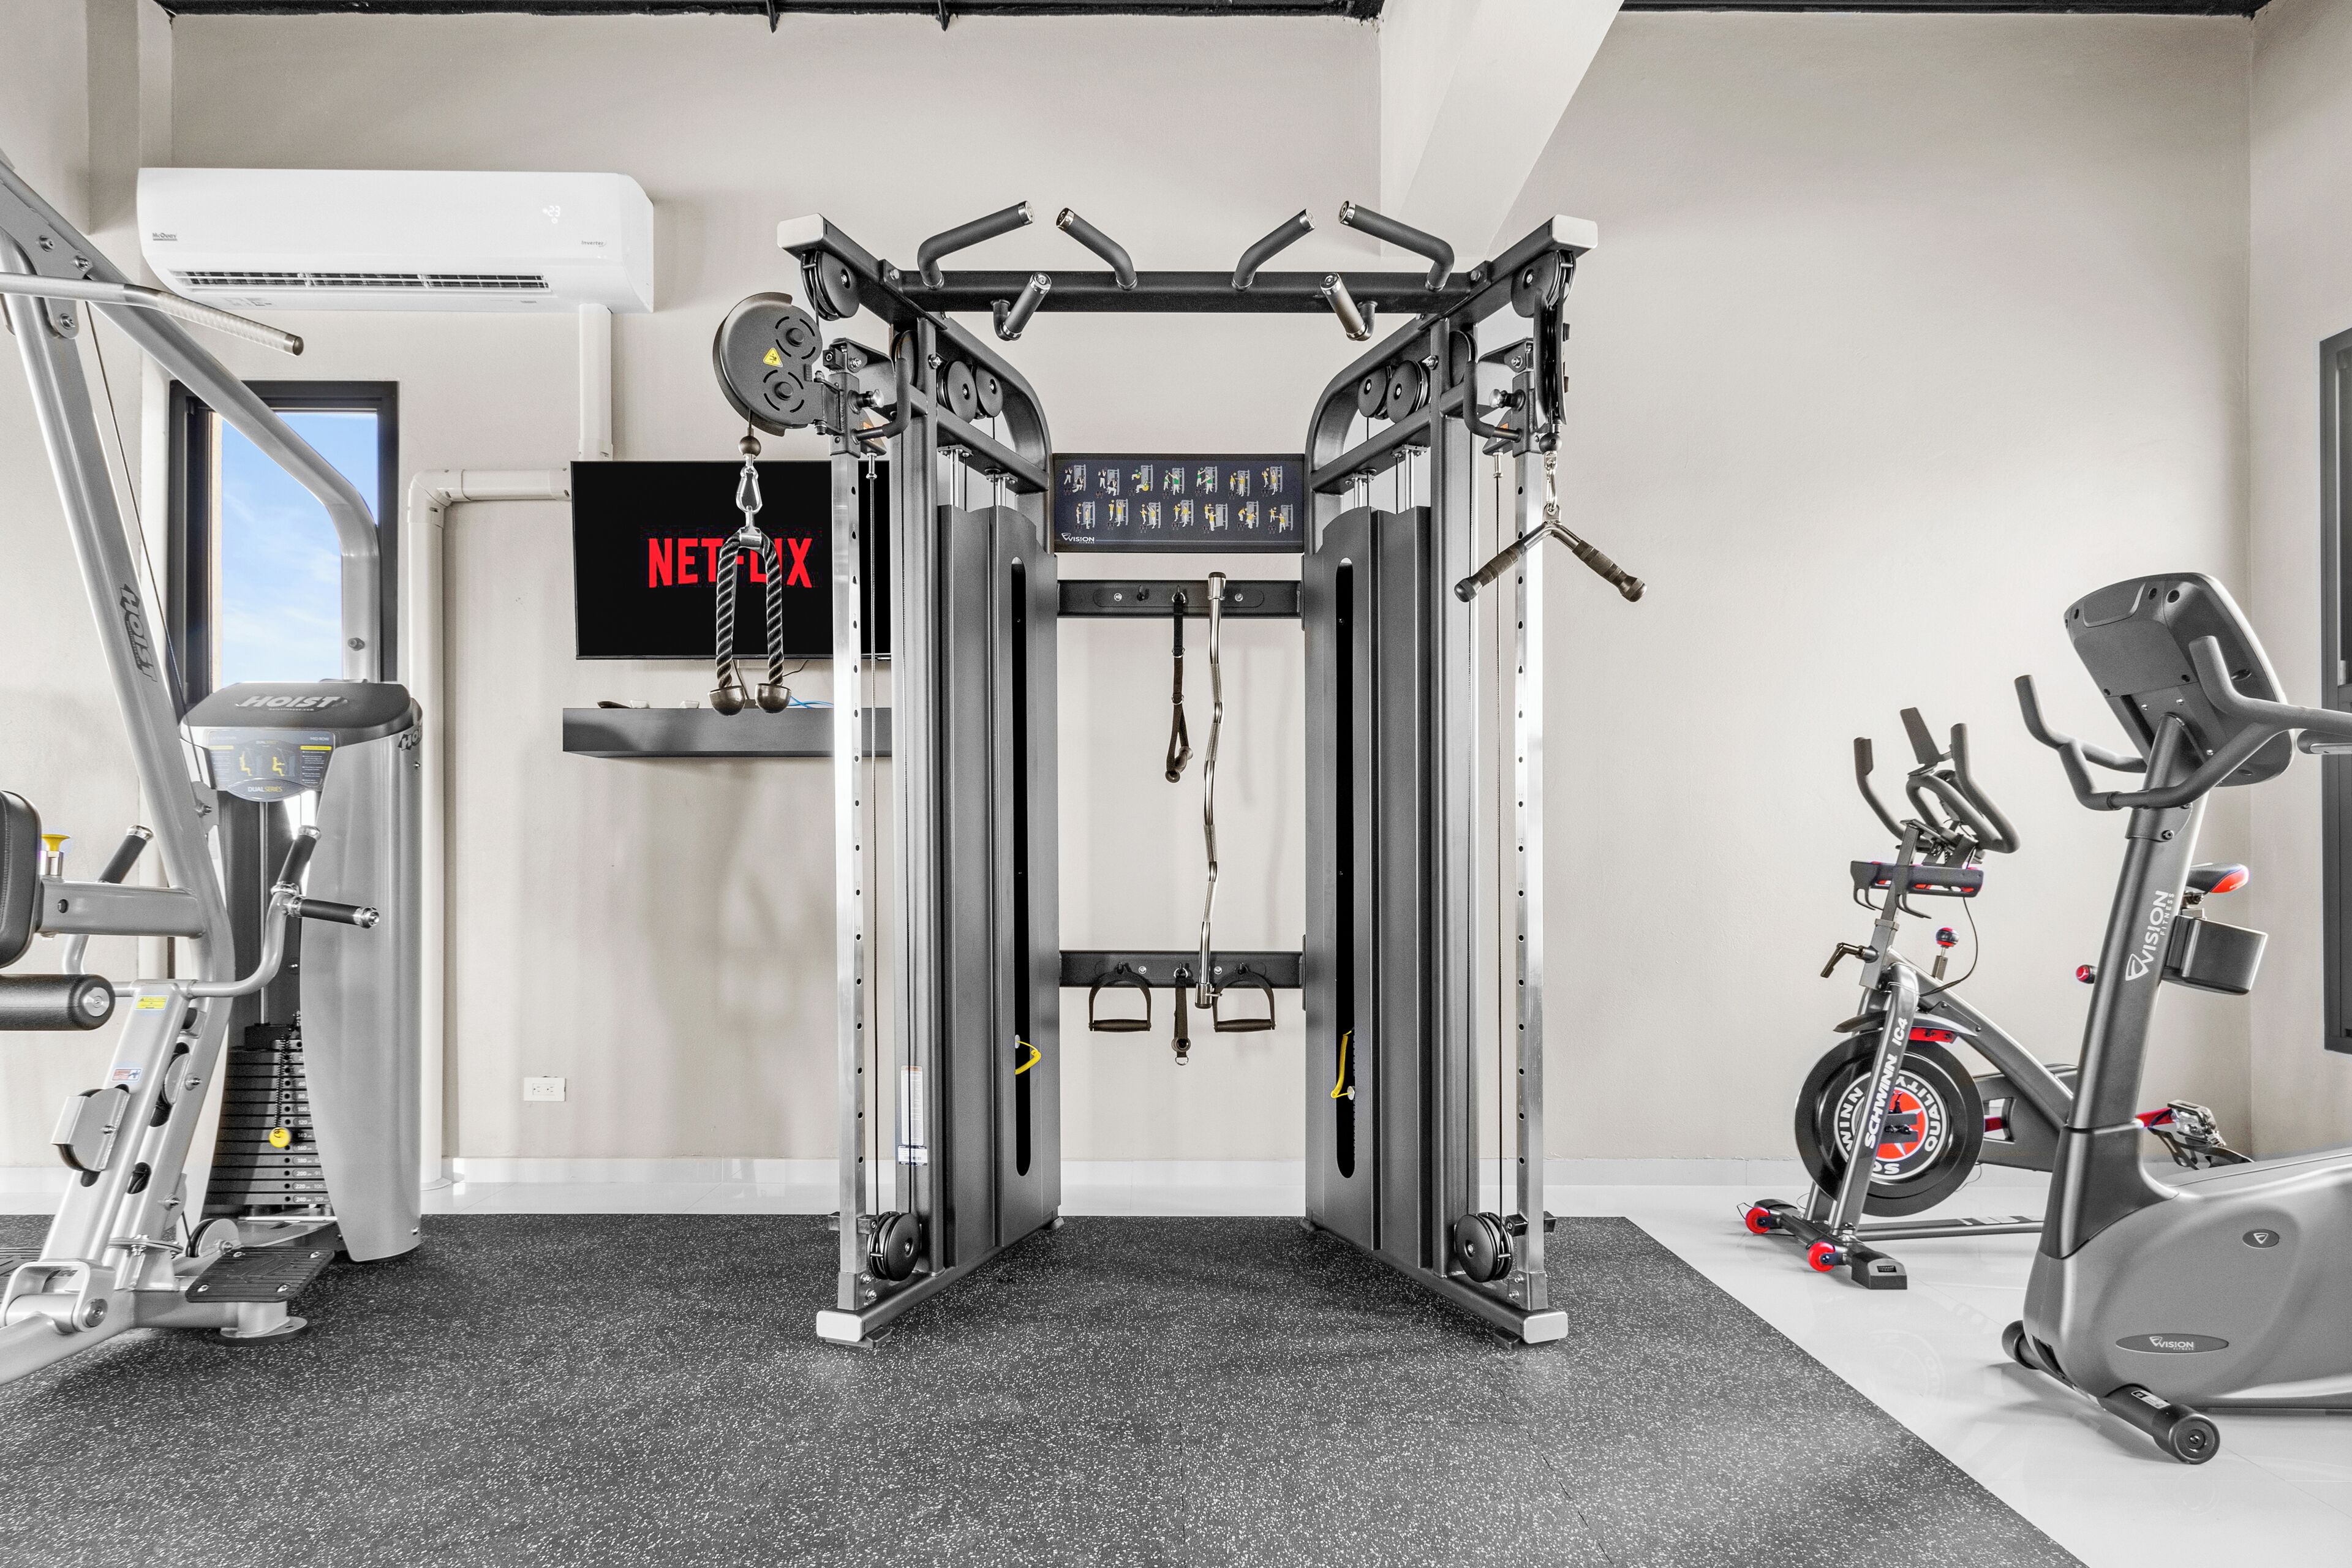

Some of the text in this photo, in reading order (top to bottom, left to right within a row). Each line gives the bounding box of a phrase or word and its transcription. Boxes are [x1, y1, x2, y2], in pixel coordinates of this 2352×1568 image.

[548, 205, 560, 217] 23
[648, 538, 813, 589] NETLX
[119, 585, 157, 682] HOIST
[239, 696, 342, 707] HOIST
[2141, 889, 2169, 964] VISION
[2160, 892, 2174, 936] FITNESS
[1864, 1017, 1909, 1149] SCHWINN IC4
[1895, 1076, 1942, 1152] QUALITY
